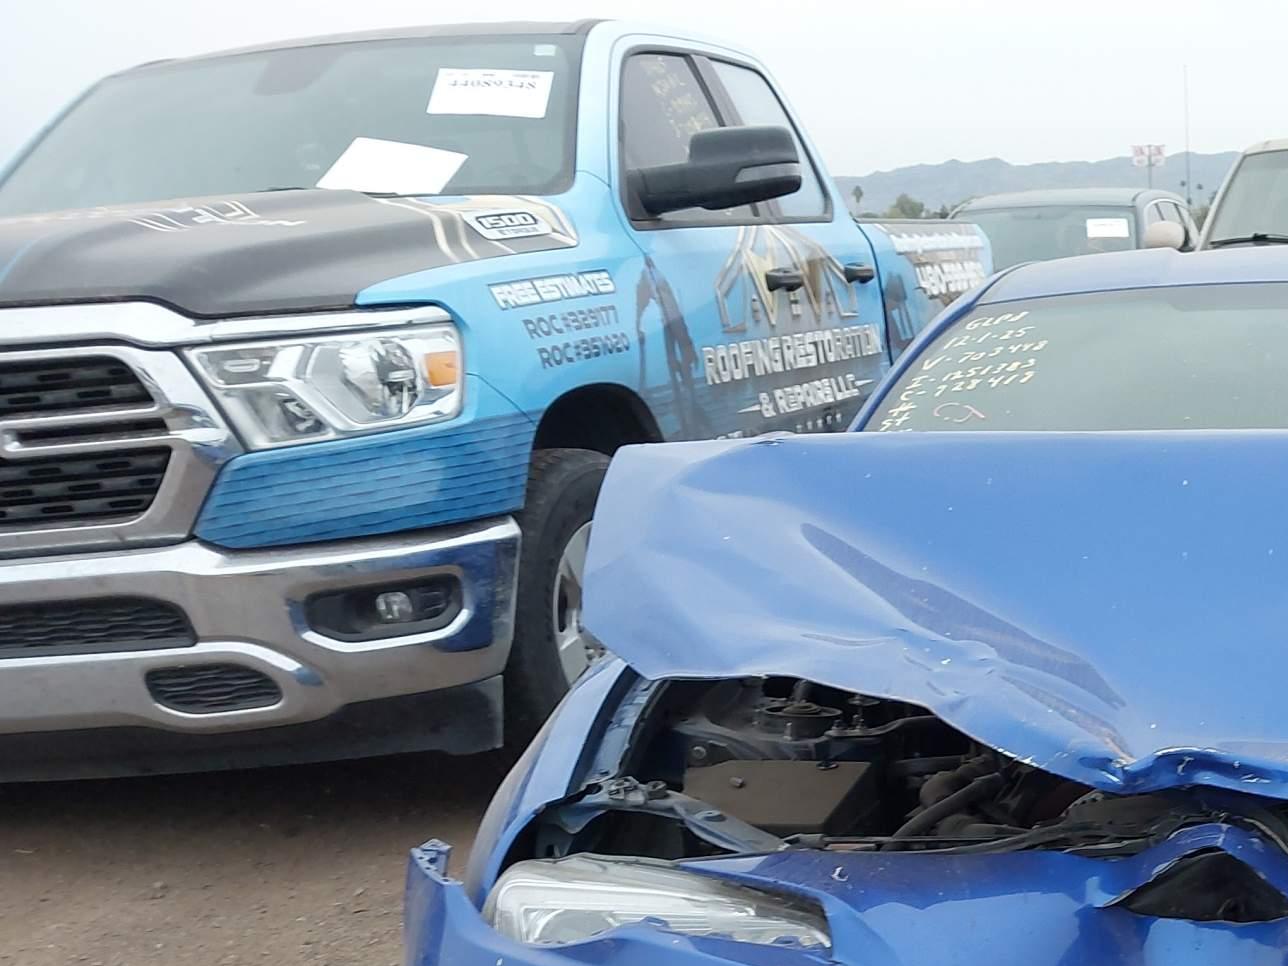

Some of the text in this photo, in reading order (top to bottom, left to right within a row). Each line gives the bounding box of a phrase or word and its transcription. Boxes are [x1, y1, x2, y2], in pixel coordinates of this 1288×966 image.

[477, 213, 537, 229] 1500
[488, 269, 616, 310] FREE ESTIMATES
[522, 313, 564, 340] ROC
[536, 342, 575, 369] ROC
[758, 391, 778, 418] &
